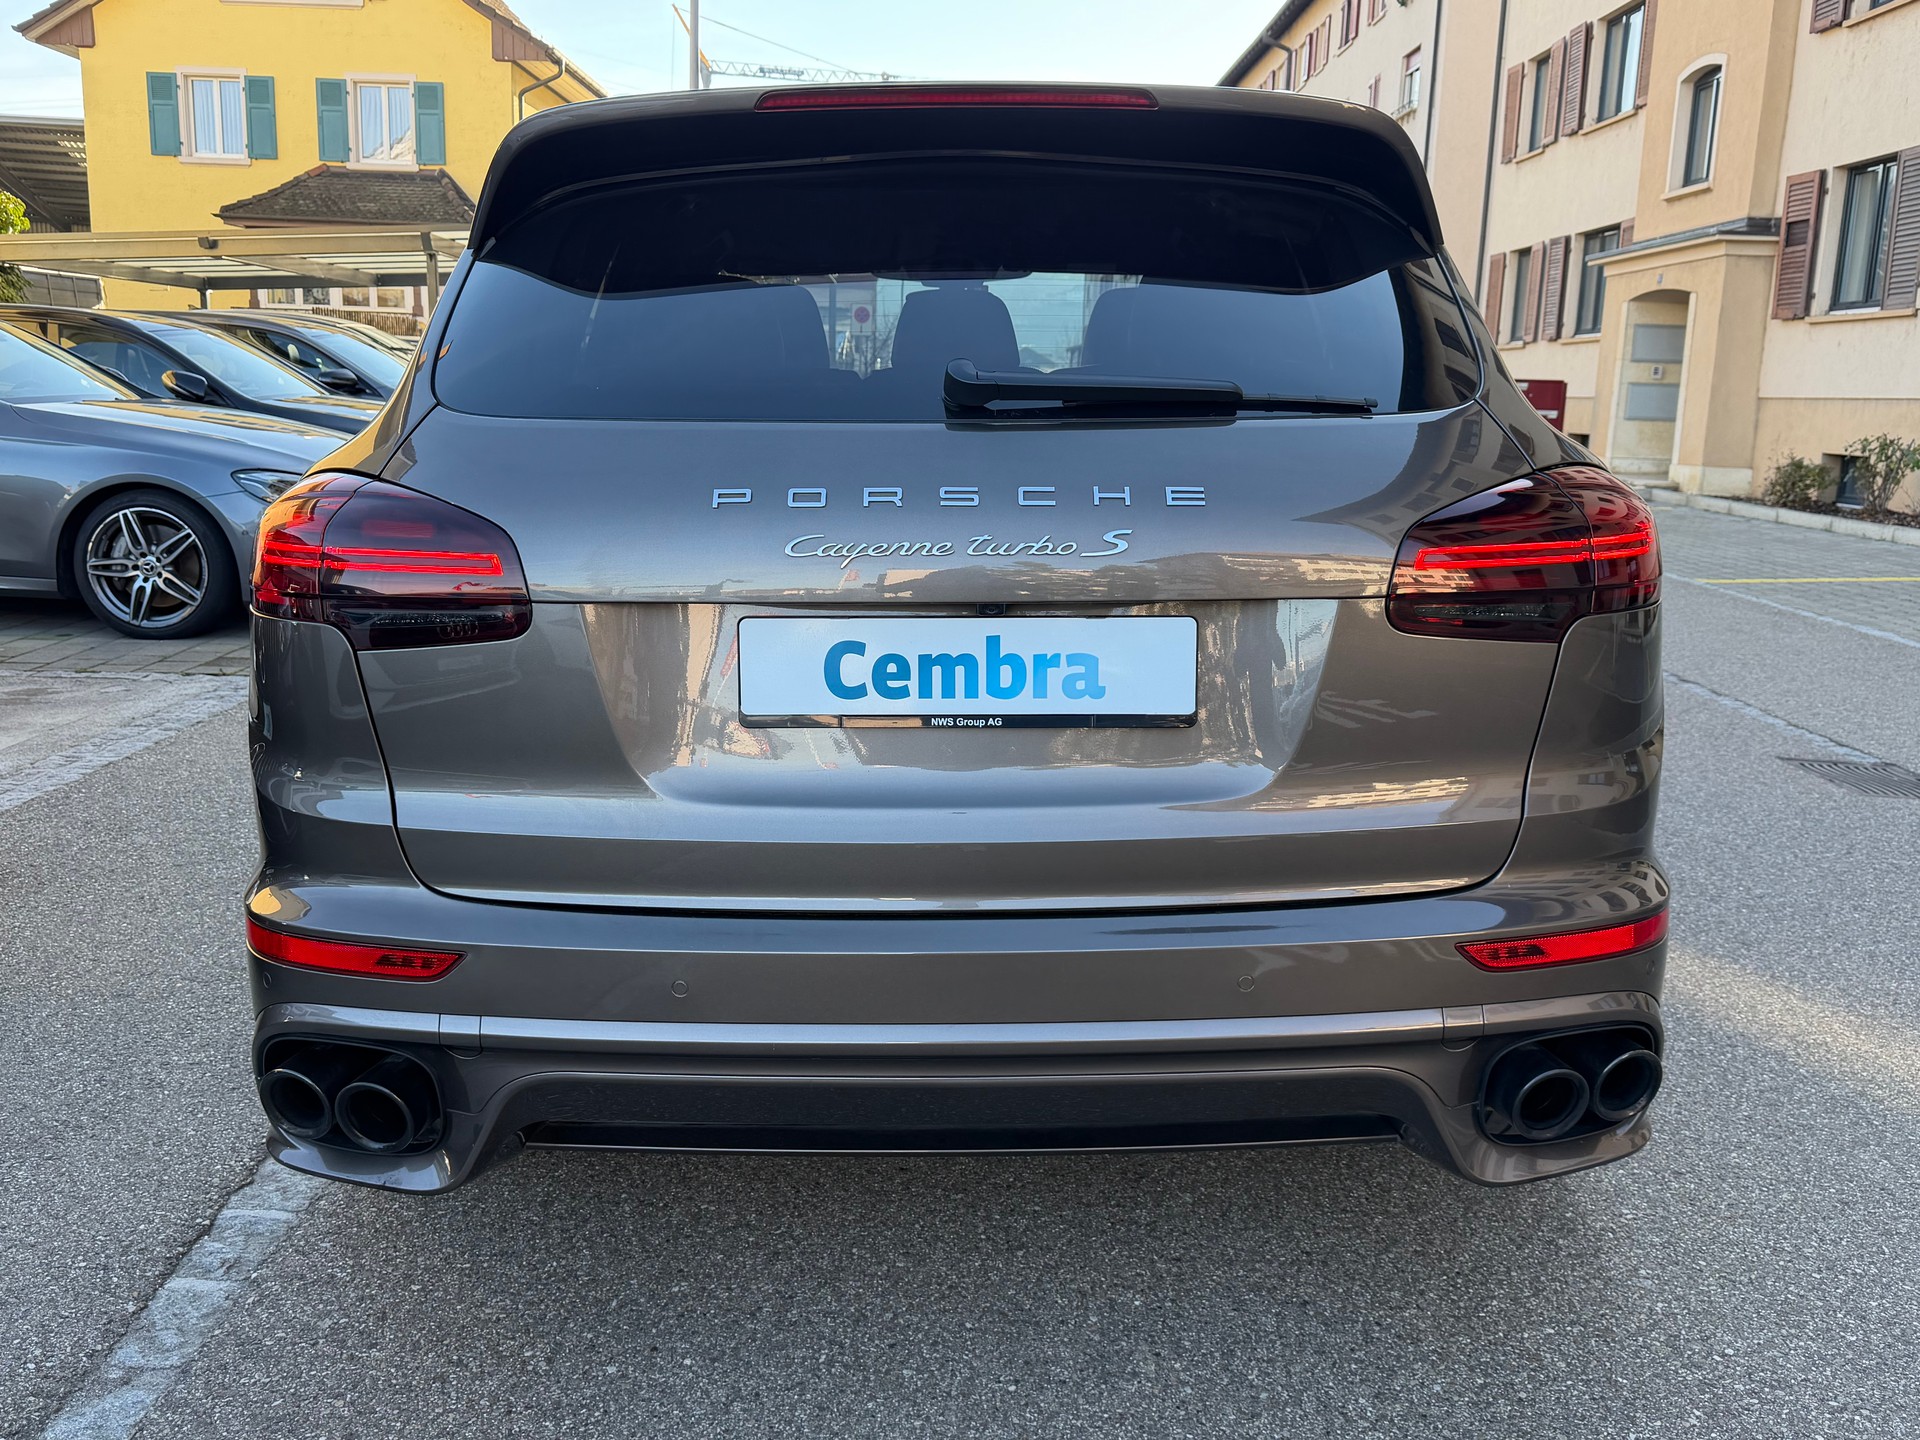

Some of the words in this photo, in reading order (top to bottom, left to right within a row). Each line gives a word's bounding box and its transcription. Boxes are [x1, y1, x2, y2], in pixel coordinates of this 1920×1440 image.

[712, 486, 1206, 509] PORSCHE
[784, 534, 956, 569] Cayenne
[1079, 529, 1133, 558] S
[823, 634, 1107, 700] Cembra
[931, 717, 954, 726] NWS
[956, 717, 986, 728] Group
[987, 717, 1003, 726] AG
